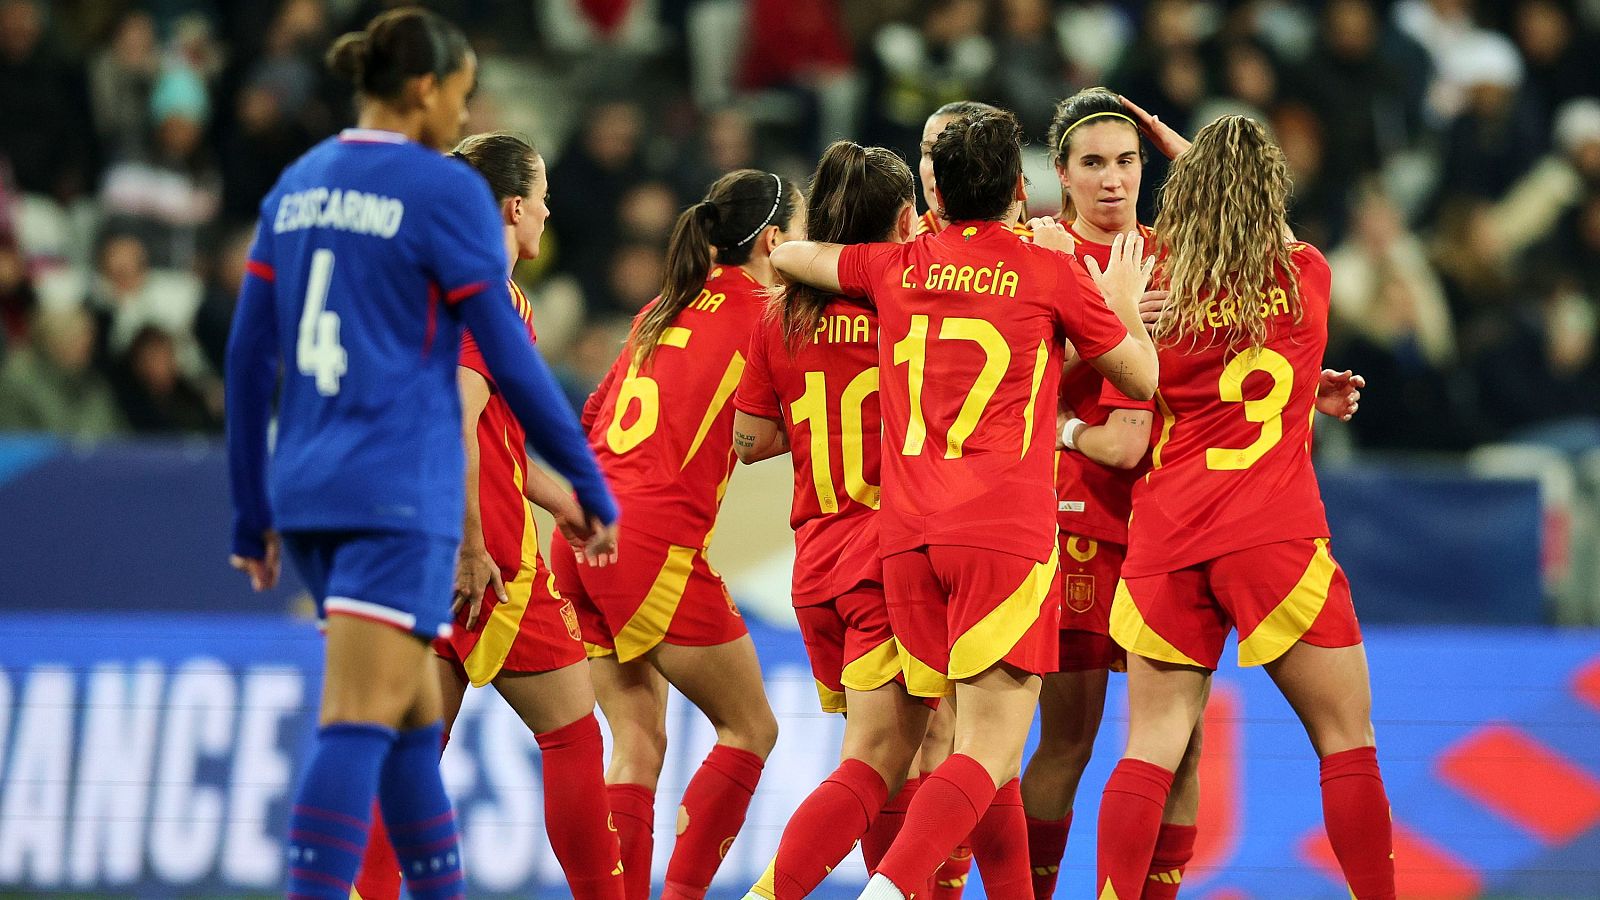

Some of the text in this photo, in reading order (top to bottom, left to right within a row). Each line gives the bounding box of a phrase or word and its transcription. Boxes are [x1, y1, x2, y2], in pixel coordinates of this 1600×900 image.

[297, 249, 348, 397] 4
[814, 315, 869, 345] PINA
[902, 261, 1019, 298] L. GARCÍA
[606, 327, 693, 455] 6
[790, 367, 881, 514] 10
[893, 314, 1012, 460] 17
[1205, 346, 1294, 470] 3
[0, 655, 304, 887] ANCE
